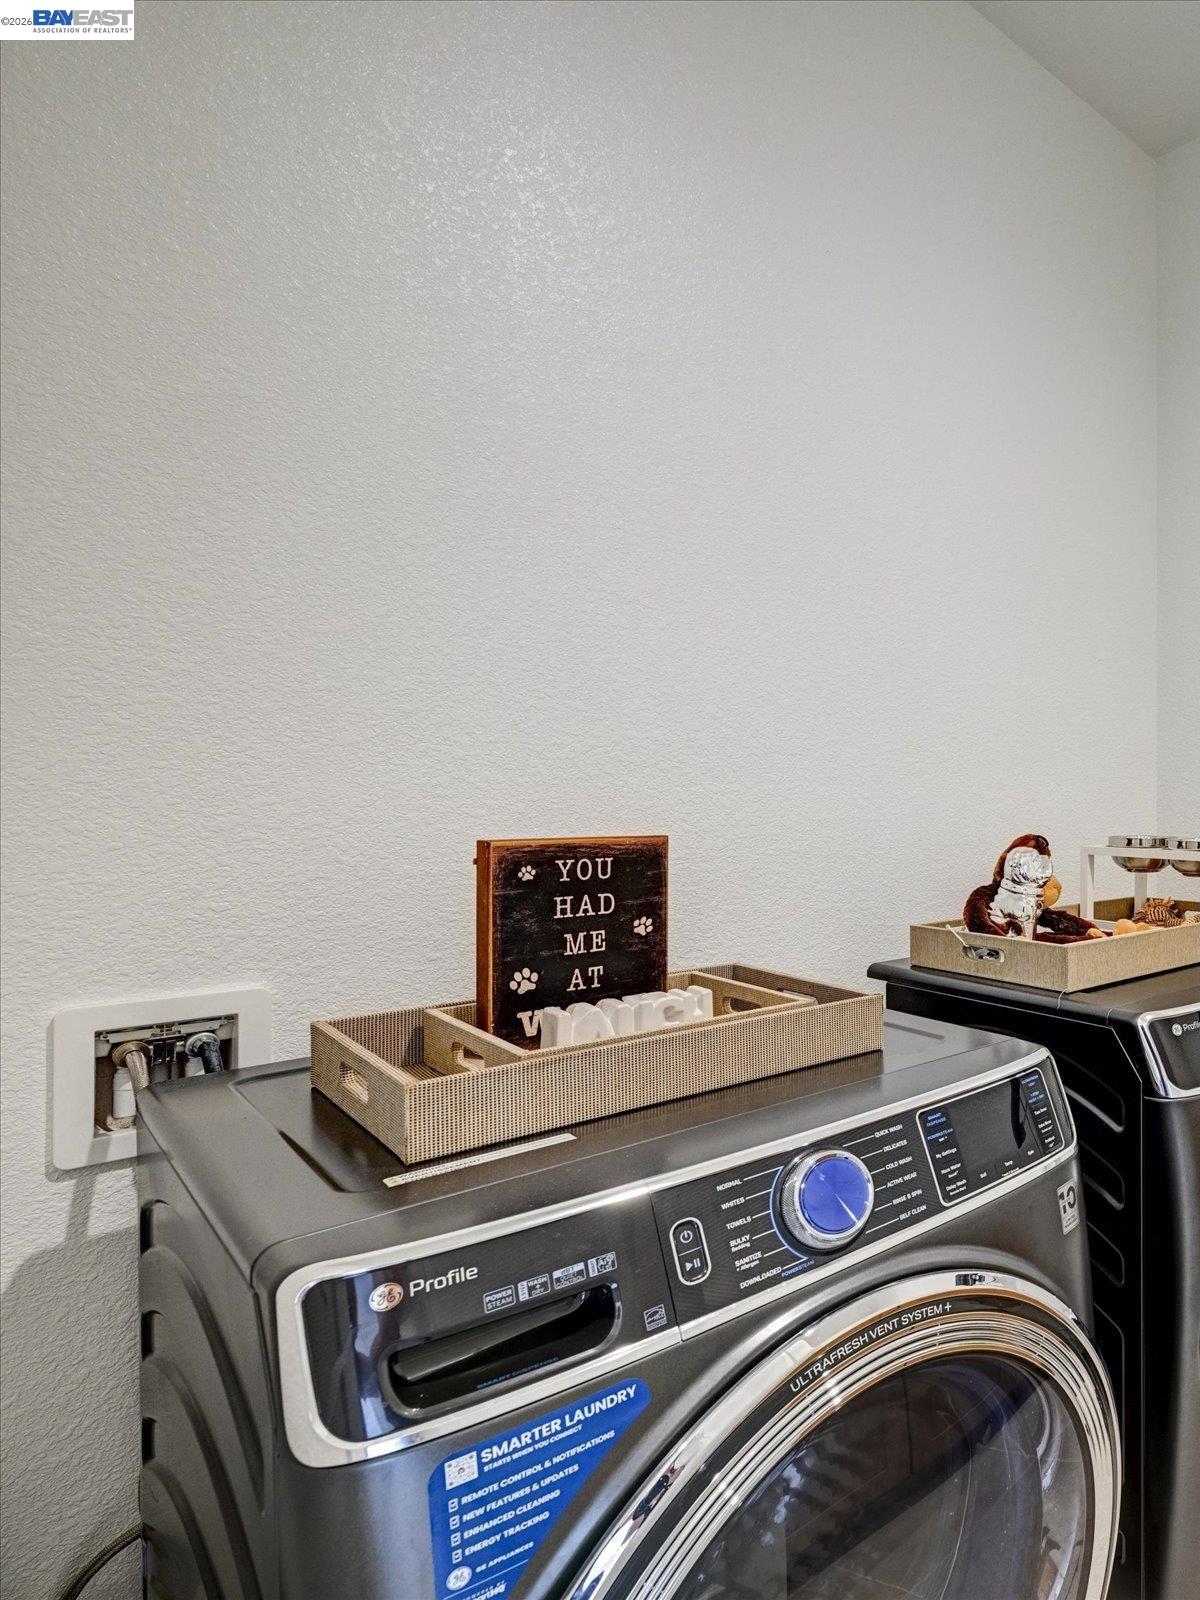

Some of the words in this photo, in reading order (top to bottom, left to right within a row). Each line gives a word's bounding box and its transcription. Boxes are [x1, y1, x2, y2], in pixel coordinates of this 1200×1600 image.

[555, 857, 613, 882] YOU
[553, 893, 615, 919] HAD
[564, 930, 606, 956] ME
[566, 966, 604, 992] AT
[874, 1129, 889, 1138] QUICK
[889, 1124, 903, 1133] WASH
[882, 1139, 907, 1152] DELICATES
[885, 1161, 899, 1170] COLD
[898, 1156, 913, 1165] WASH
[716, 1179, 743, 1192] NORMAL
[887, 1177, 903, 1188] ACTIVE
[903, 1171, 917, 1181] WEAR
[911, 1188, 923, 1197] SPIN
[720, 1197, 745, 1210] WHITES
[899, 1211, 911, 1220] SELF
[911, 1204, 927, 1215] CLEAN
[726, 1215, 752, 1229] TOWELS
[729, 1234, 750, 1247] BULKY
[731, 1242, 751, 1253] Bedding
[734, 1251, 762, 1267] SANITIZE
[740, 1260, 759, 1271] Allergen
[781, 1260, 815, 1277] POWERSTEAM
[409, 1266, 478, 1297] Profile
[527, 1276, 548, 1287] WASH
[740, 1266, 782, 1289] DOWNLOADED
[485, 1288, 513, 1302] POWER
[486, 1296, 513, 1310] STEAM
[789, 1330, 869, 1393] ULTRAFRESH
[870, 1317, 900, 1340] VENT
[901, 1304, 944, 1325] SYSTEM
[480, 1418, 562, 1463] SMARTER
[565, 1384, 637, 1427] LAUNDRY
[483, 1457, 511, 1472] STARTS
[511, 1446, 534, 1461] WHEN
[534, 1439, 550, 1451] YOU
[550, 1424, 583, 1443] CONNECT
[461, 1482, 499, 1505] REMOTE
[500, 1464, 543, 1488] CONTROL
[544, 1460, 552, 1469] &
[552, 1430, 615, 1465] NOTIFICATIONS
[462, 1506, 485, 1522] NEW
[486, 1486, 531, 1512] FEATURES
[532, 1482, 540, 1491] &
[540, 1464, 580, 1487] UPDATES
[463, 1510, 515, 1539] ENHANCED
[516, 1489, 561, 1515] CLEANING
[464, 1532, 501, 1556] ENERGY
[503, 1511, 550, 1538] TRACKING
[475, 1564, 487, 1573] GE
[487, 1541, 534, 1568] APPLIANCES
